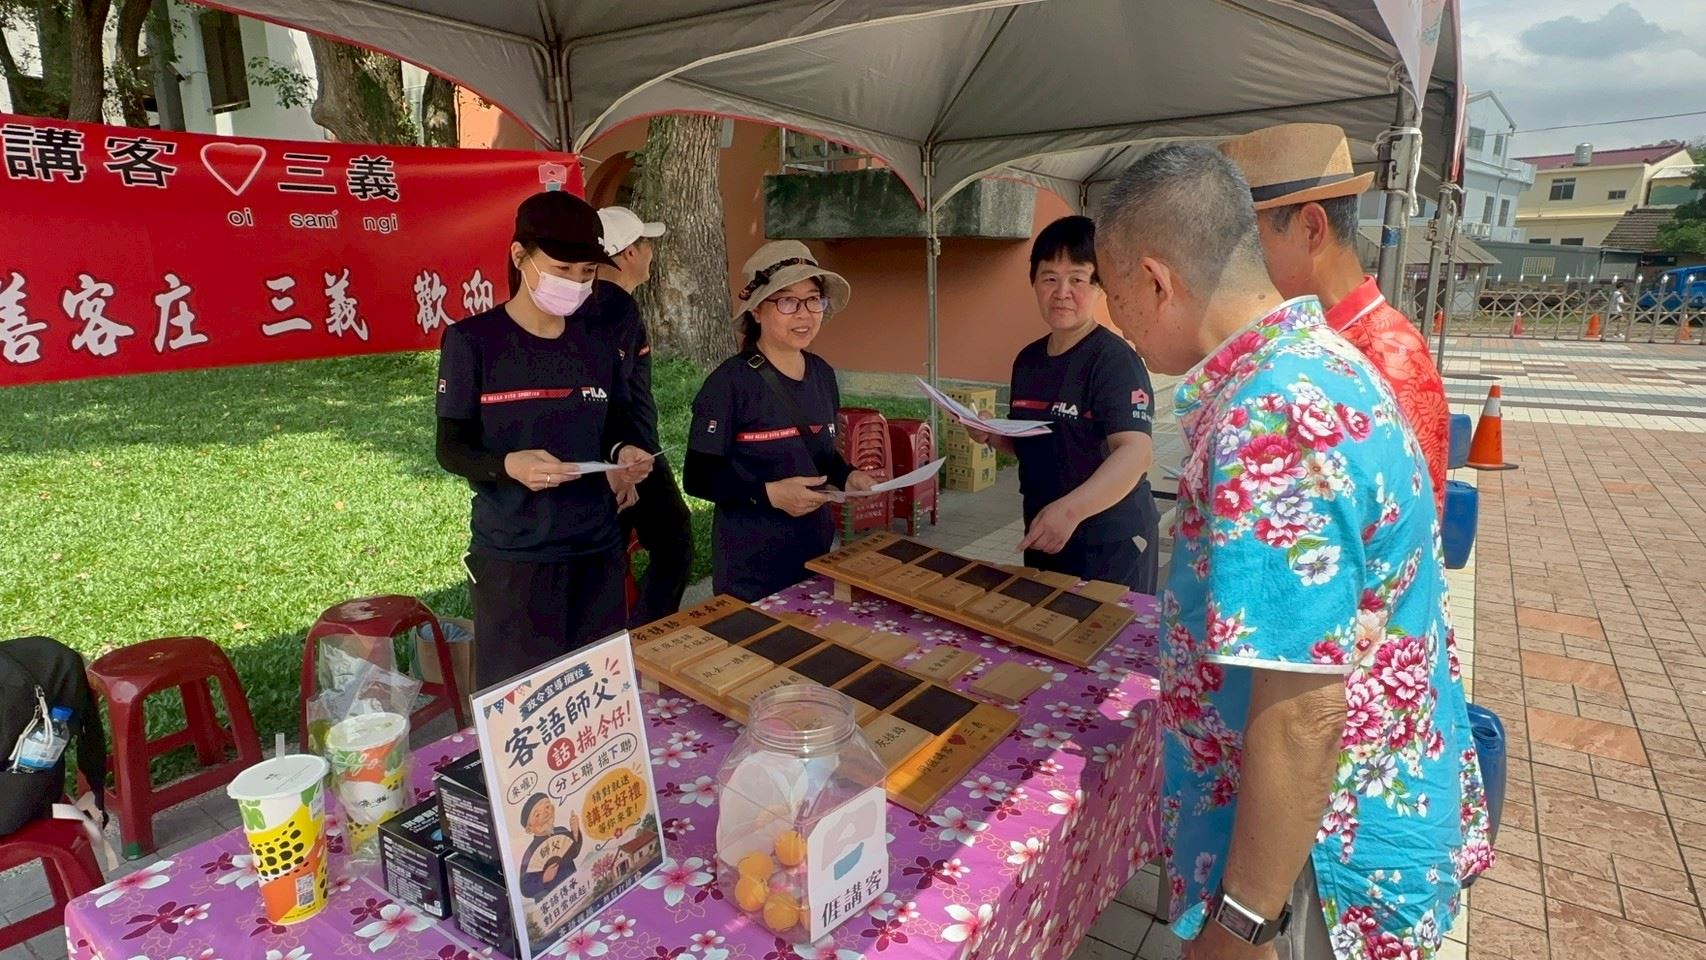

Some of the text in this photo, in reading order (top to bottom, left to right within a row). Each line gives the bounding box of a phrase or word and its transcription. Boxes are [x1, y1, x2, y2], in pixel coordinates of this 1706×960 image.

[2, 123, 401, 203] 講客 三義
[227, 207, 254, 228] oi
[363, 212, 399, 234] ngi
[261, 267, 370, 342] 三義
[413, 269, 496, 335] 歡迎
[581, 386, 608, 399] FILA
[1051, 401, 1079, 416] FILA
[503, 676, 616, 771] 客語師父
[554, 738, 632, 793] 分上聯 揣下聯
[585, 781, 642, 829] 講客好禮
[539, 839, 561, 860] 師父
